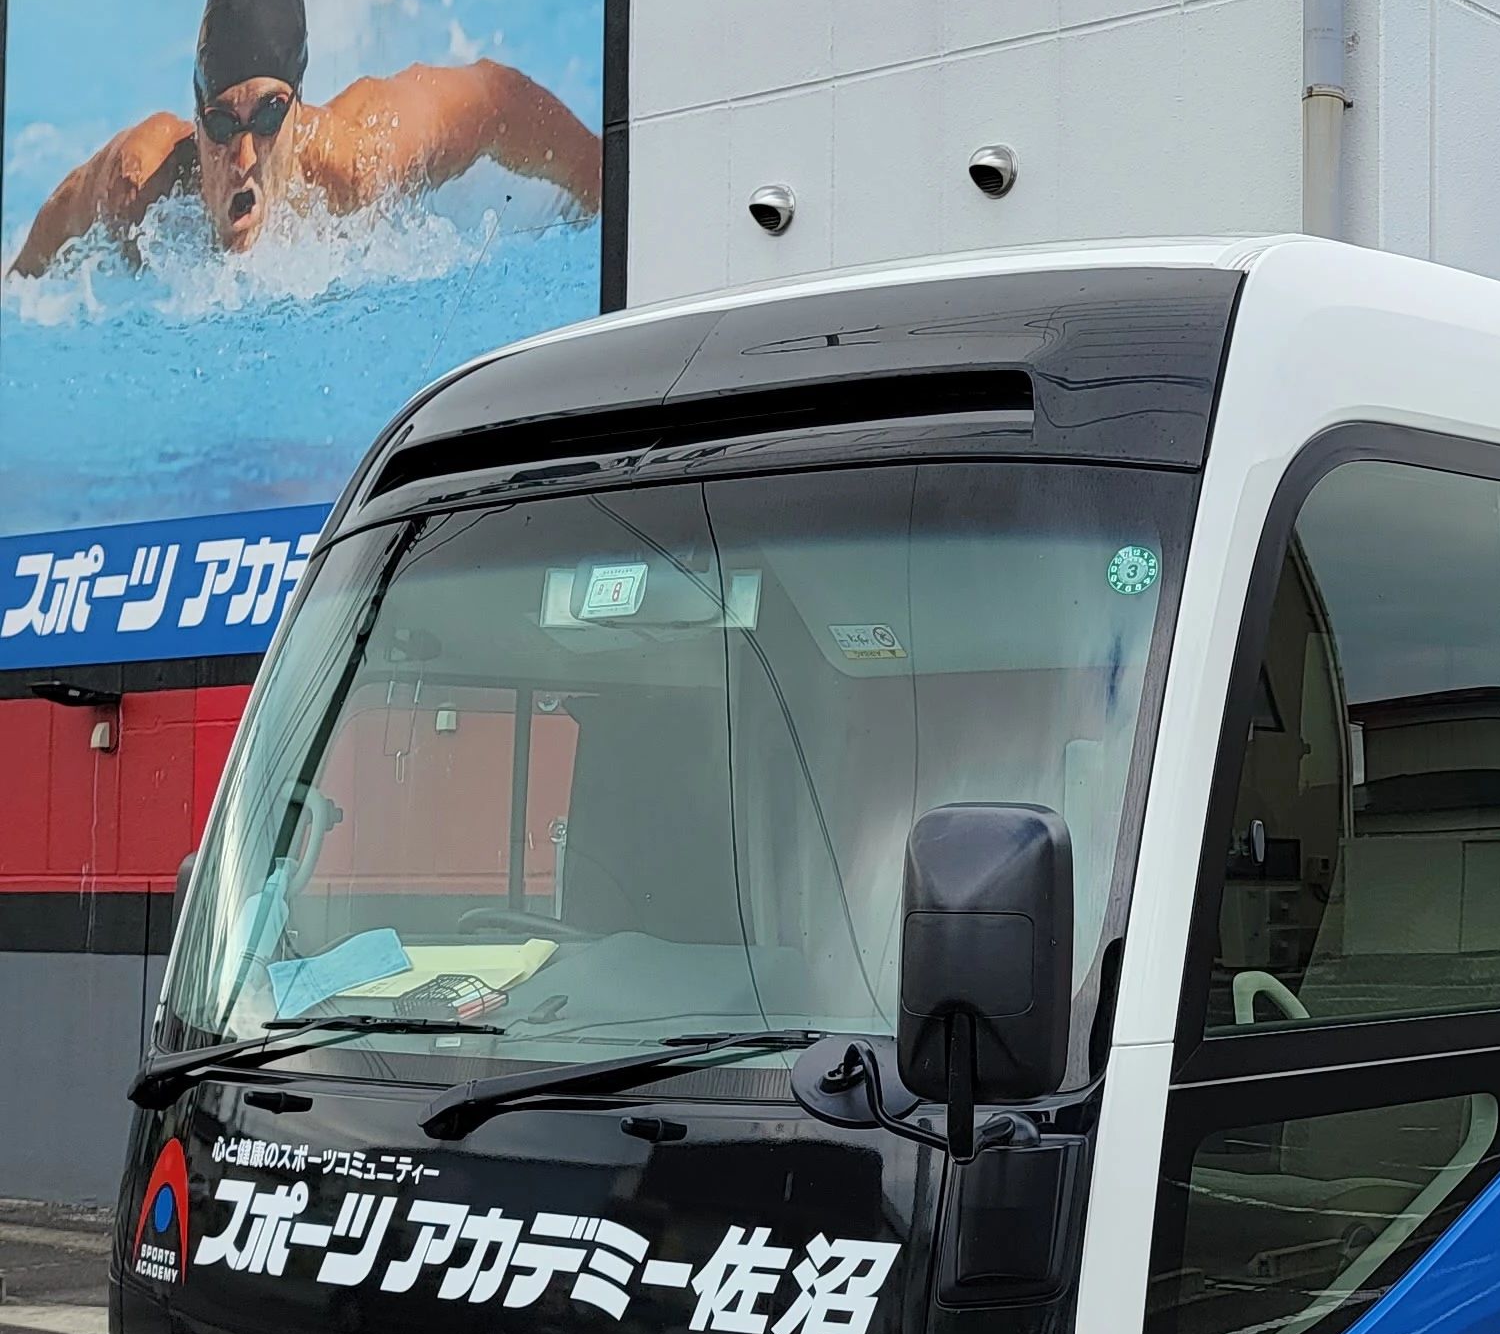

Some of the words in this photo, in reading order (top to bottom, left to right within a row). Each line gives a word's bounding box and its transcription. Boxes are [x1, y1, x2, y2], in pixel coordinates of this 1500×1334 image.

[1126, 564, 1139, 579] 3
[212, 1134, 440, 1185] 心と健康のスポーツコミュニティー
[140, 1243, 176, 1266] SPORTS
[135, 1258, 179, 1284] ACADEMY
